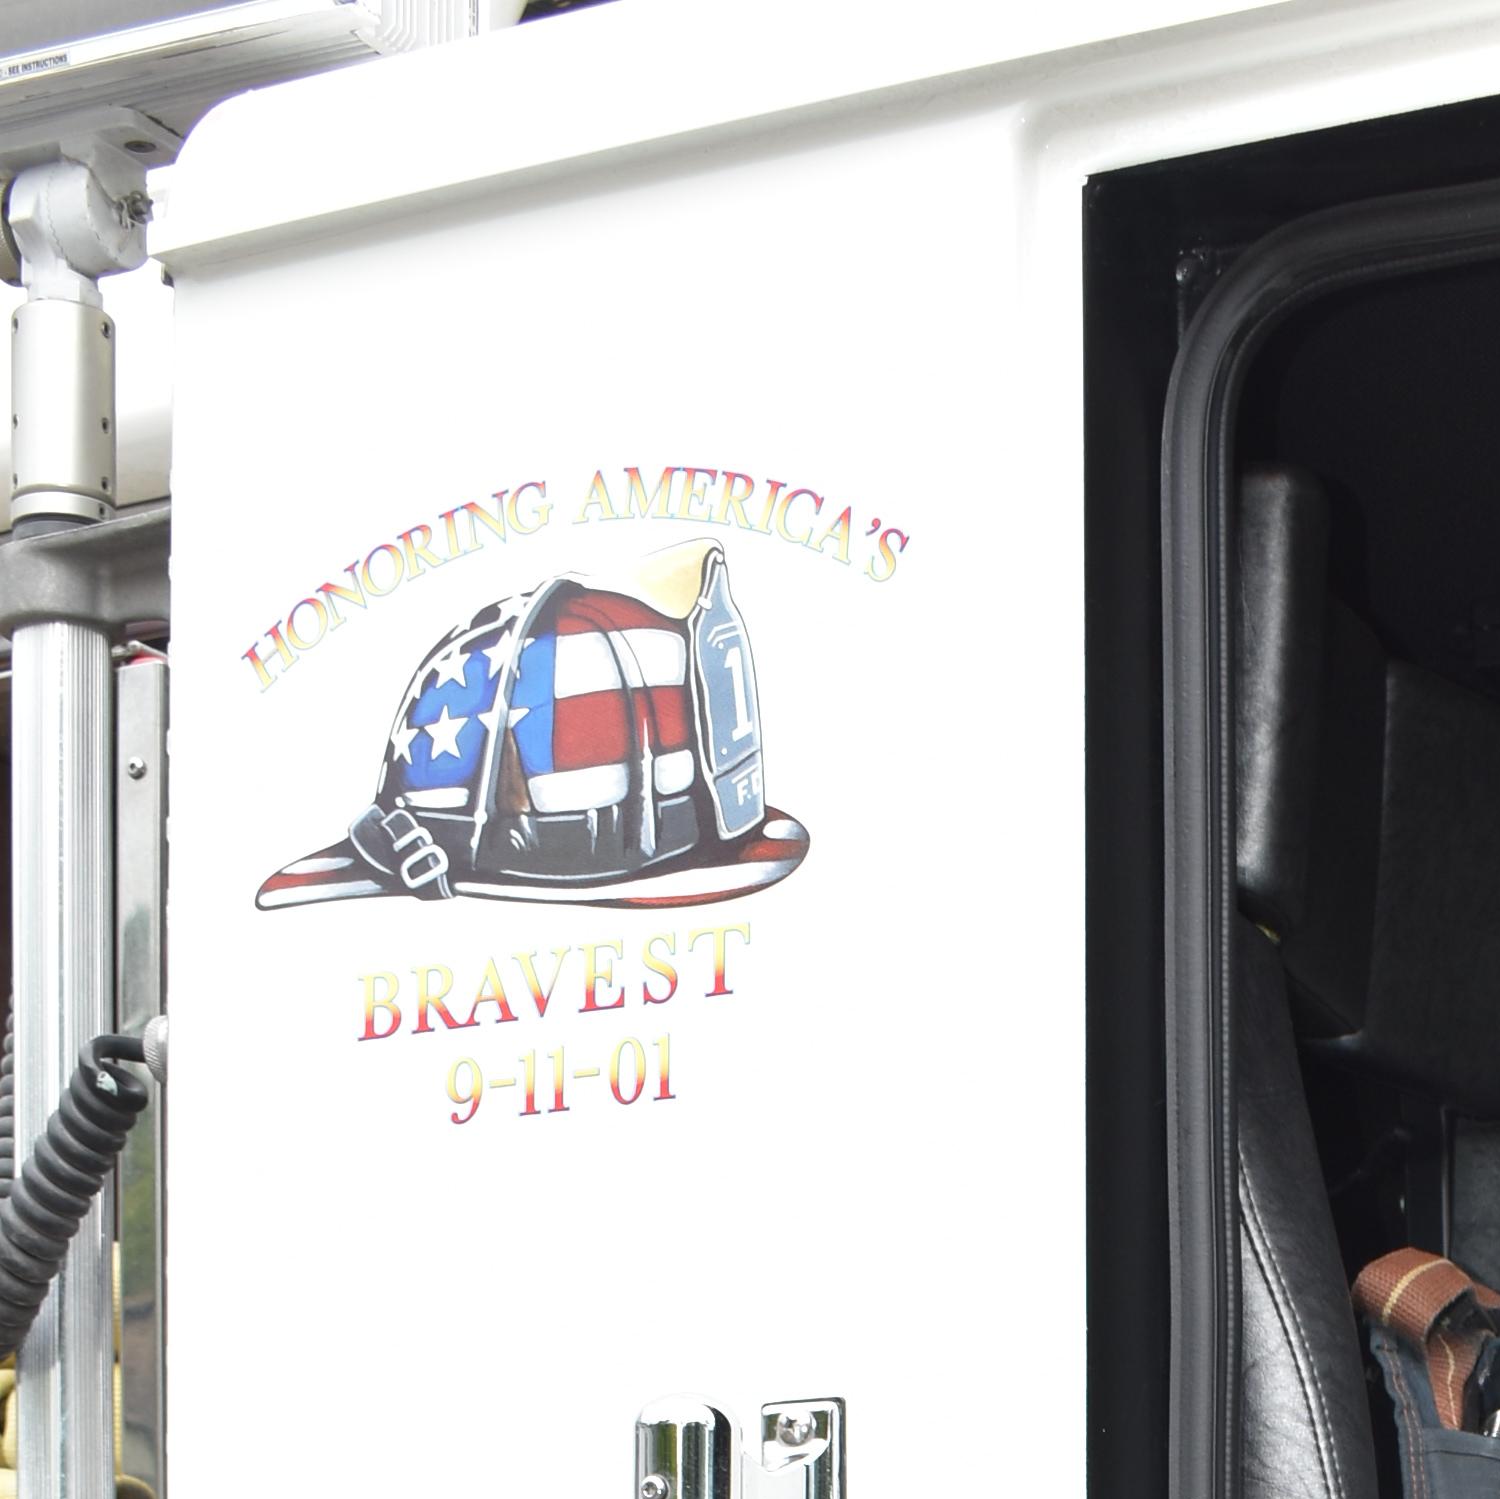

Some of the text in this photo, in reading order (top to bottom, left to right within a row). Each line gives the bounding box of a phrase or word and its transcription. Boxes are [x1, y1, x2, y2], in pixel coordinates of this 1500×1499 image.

[21, 53, 68, 73] INSTRUCTIONS
[240, 466, 911, 694] HONORING AMERICA'S
[724, 646, 754, 742] 1
[356, 921, 752, 1043] BRAVEST
[445, 1032, 677, 1126] 9-11-01
